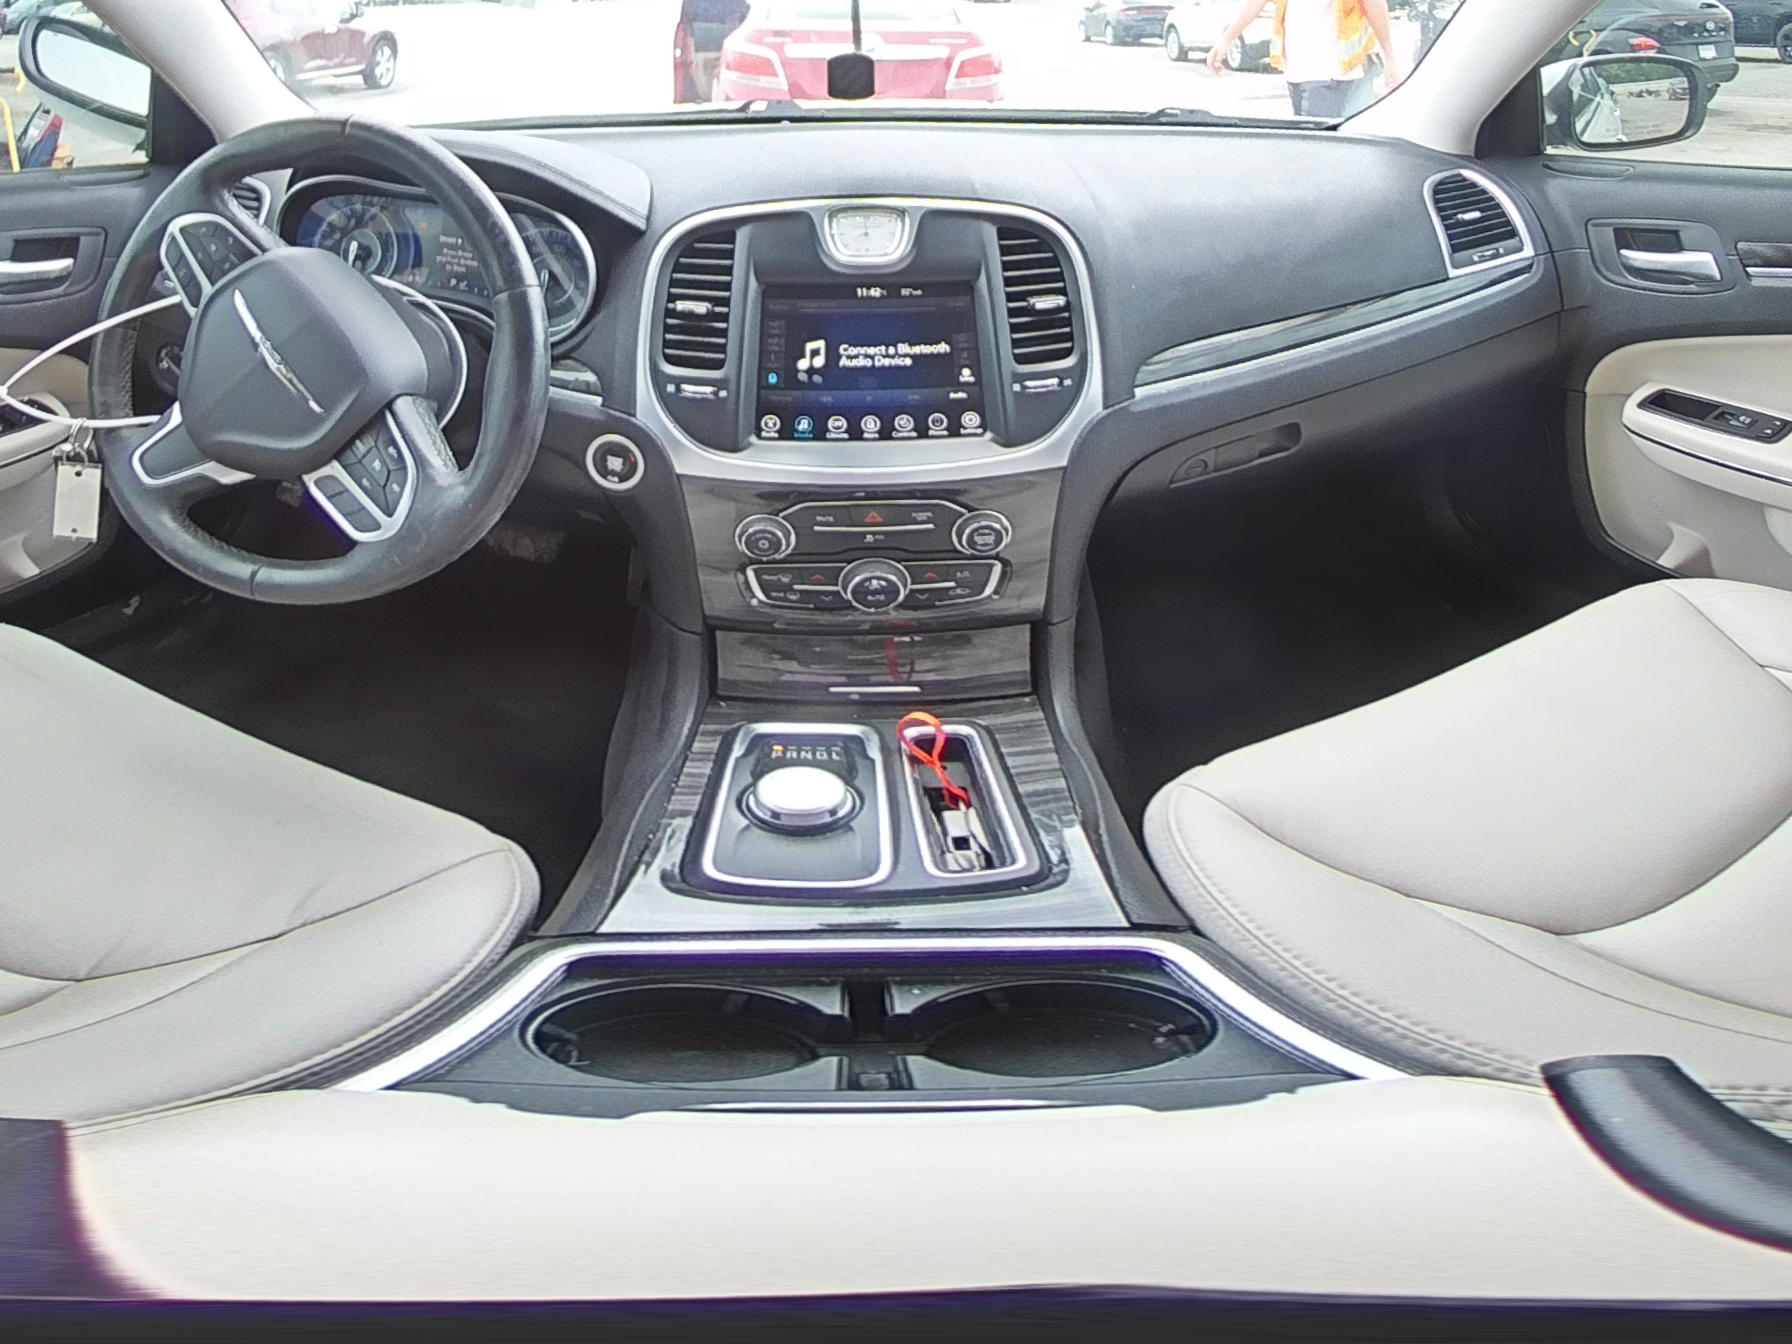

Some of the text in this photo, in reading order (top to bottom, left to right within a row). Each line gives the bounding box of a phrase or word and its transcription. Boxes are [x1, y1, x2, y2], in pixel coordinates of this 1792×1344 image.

[839, 340, 951, 355] Connect a Bluetooth
[839, 355, 913, 368] Audio Device
